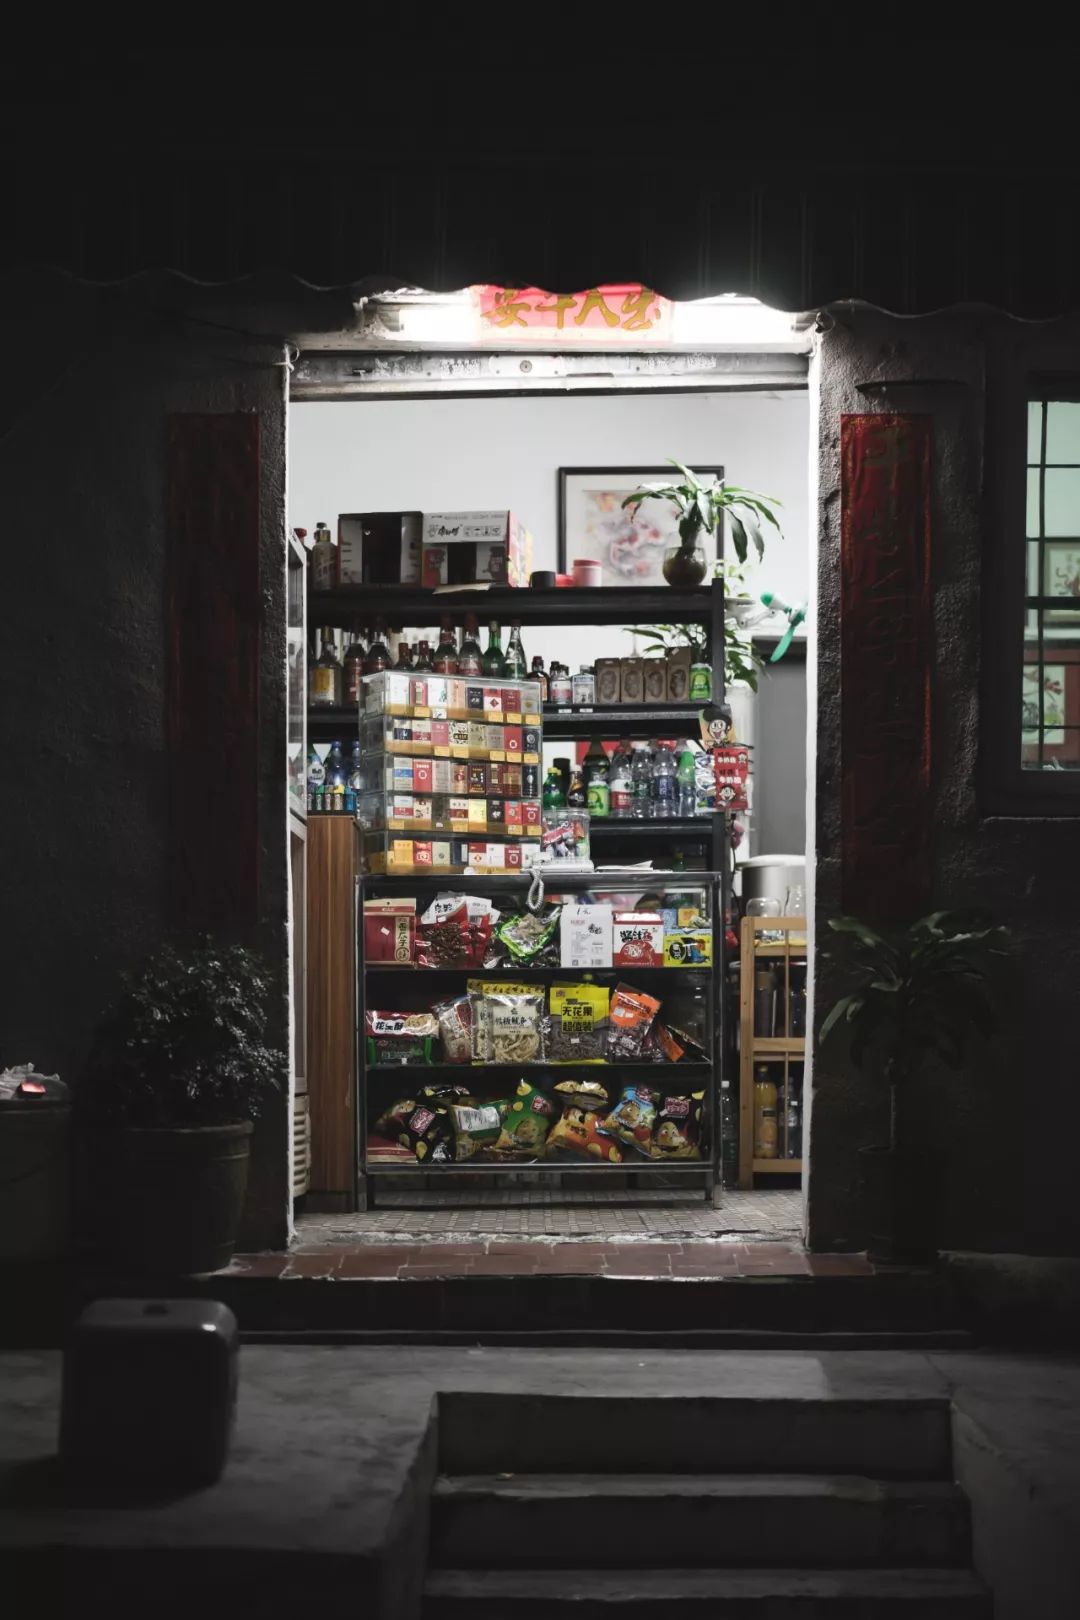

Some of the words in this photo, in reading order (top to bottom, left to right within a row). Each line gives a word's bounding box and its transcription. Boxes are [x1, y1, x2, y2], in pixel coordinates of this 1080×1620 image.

[562, 1006, 592, 1016] 无花果
[375, 1021, 404, 1031] 花生酥
